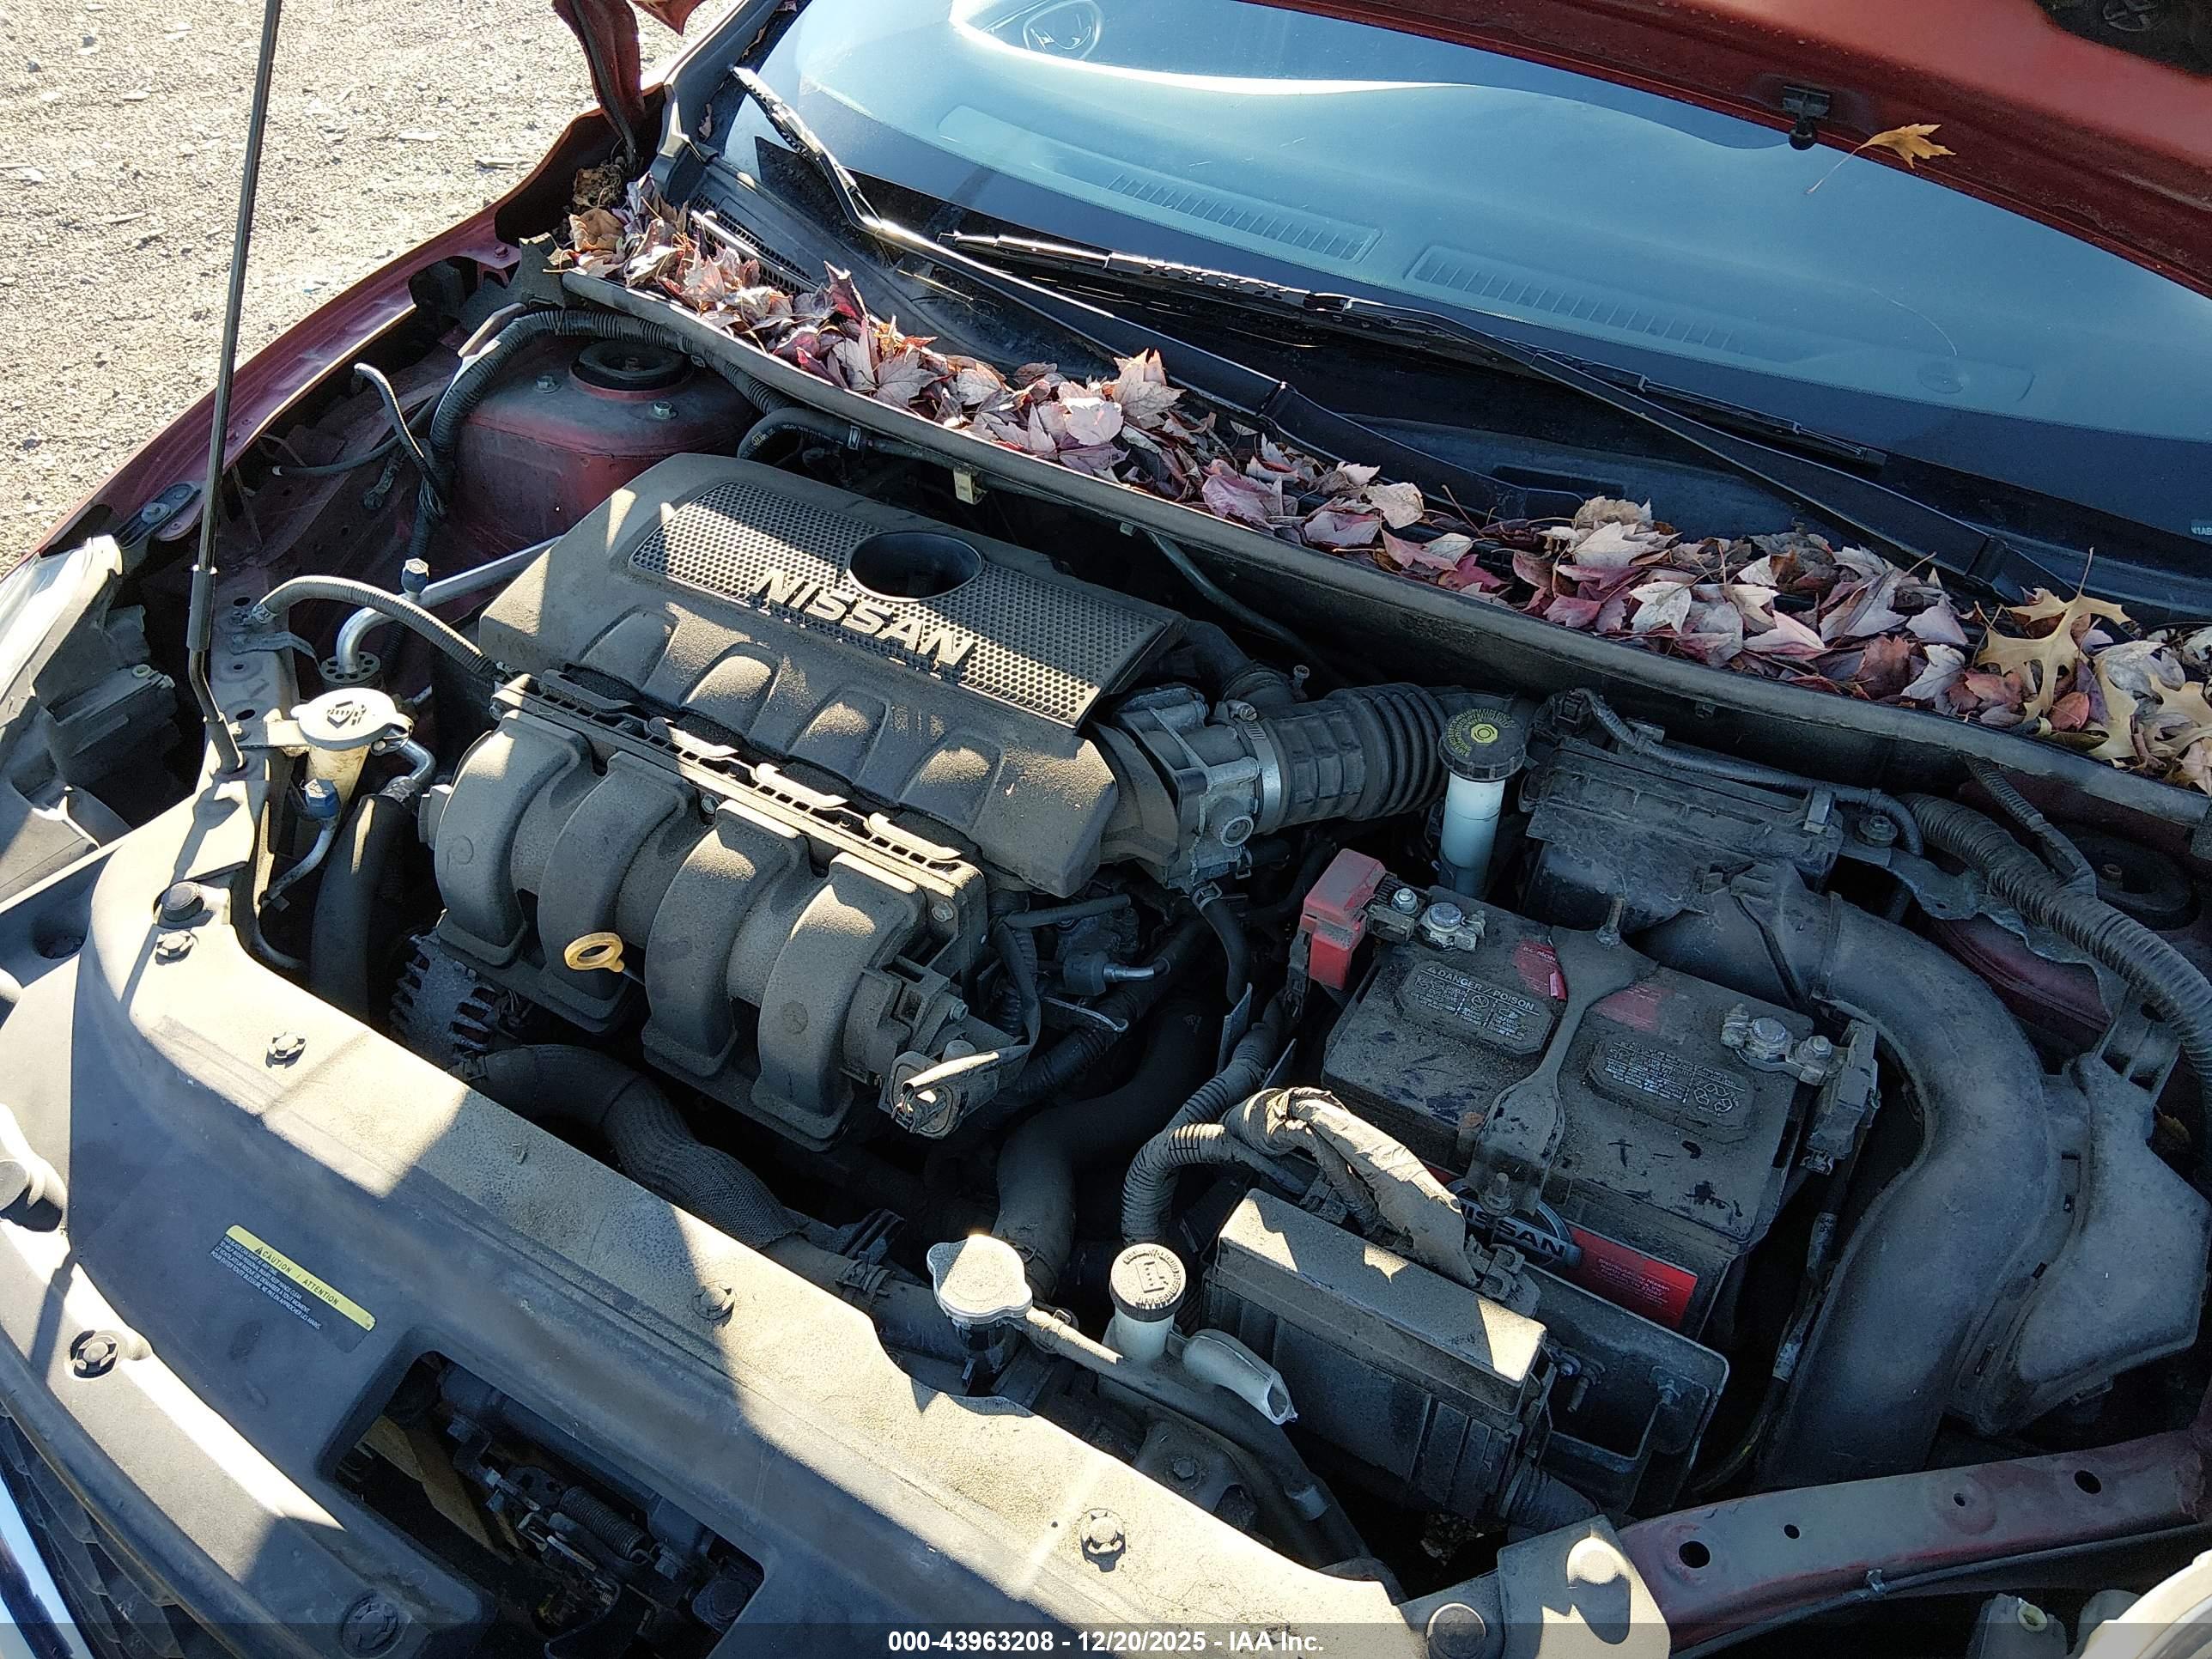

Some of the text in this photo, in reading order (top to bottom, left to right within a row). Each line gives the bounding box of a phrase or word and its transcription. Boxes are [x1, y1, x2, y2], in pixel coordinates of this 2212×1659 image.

[750, 568, 975, 666] NISSAN
[1438, 969, 1483, 991] DANGER
[1493, 990, 1534, 1011] POISON
[1461, 1204, 1565, 1257] ISSAN
[262, 1250, 292, 1273] CAUTION
[302, 1278, 339, 1306] ATTENTION
